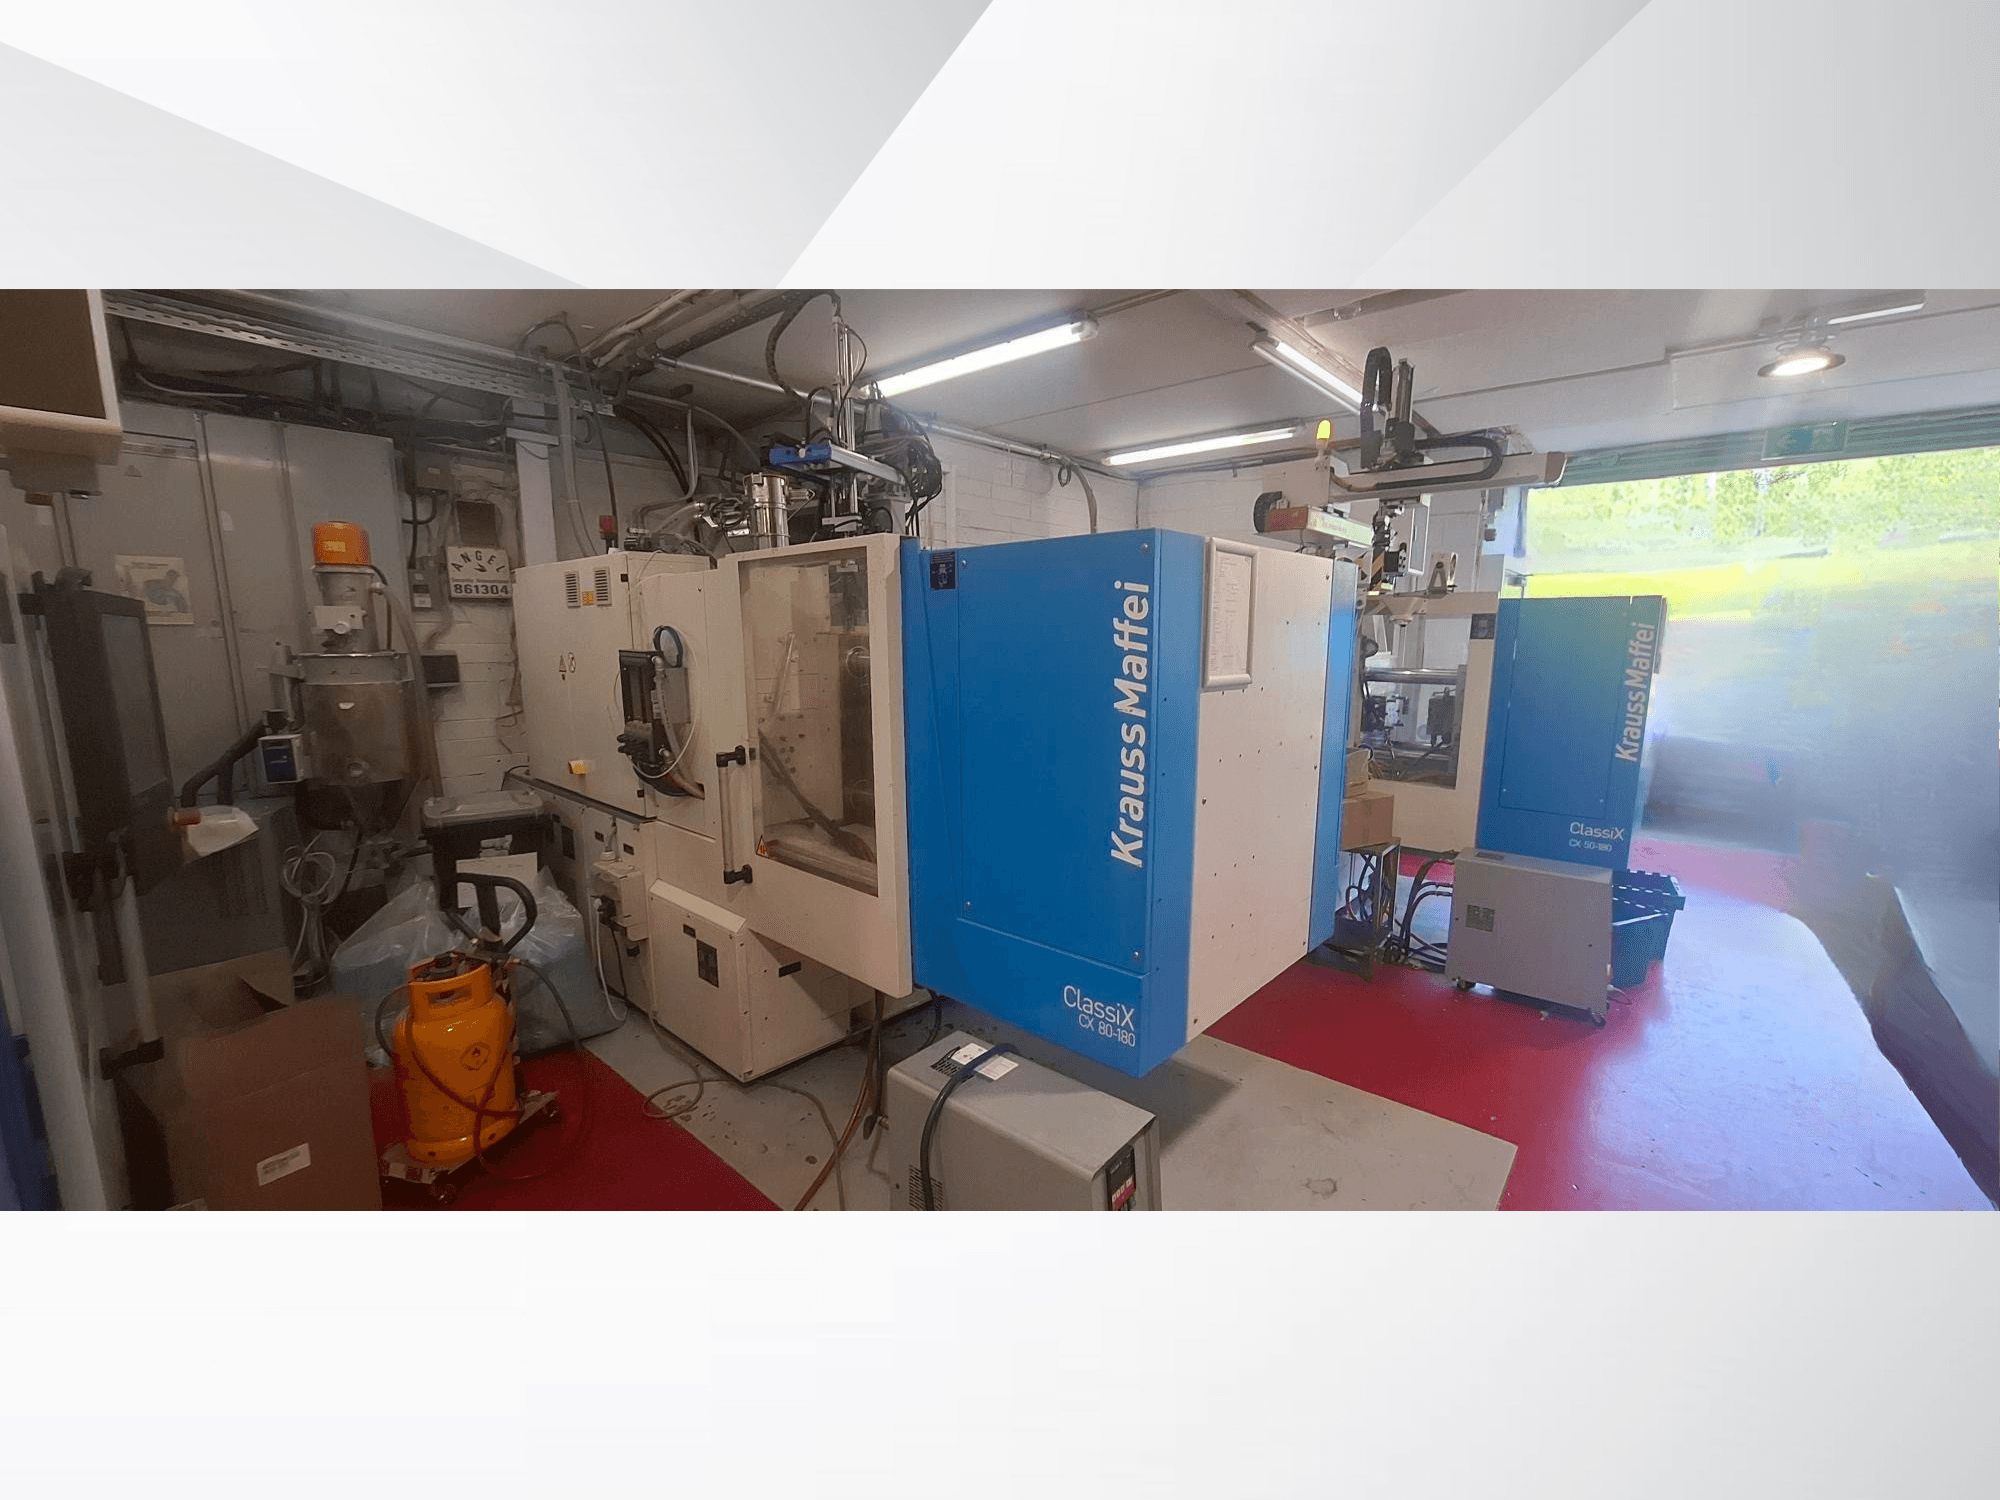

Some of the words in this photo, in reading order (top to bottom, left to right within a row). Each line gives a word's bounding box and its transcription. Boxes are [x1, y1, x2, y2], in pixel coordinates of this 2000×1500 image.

[451, 549, 506, 573] ANGEL
[453, 583, 509, 595] 861304
[1570, 821, 1624, 841] ClassiX
[1063, 985, 1135, 1031] ClassiX
[1078, 1013, 1095, 1031] CX
[1098, 1021, 1136, 1047] 80-180
